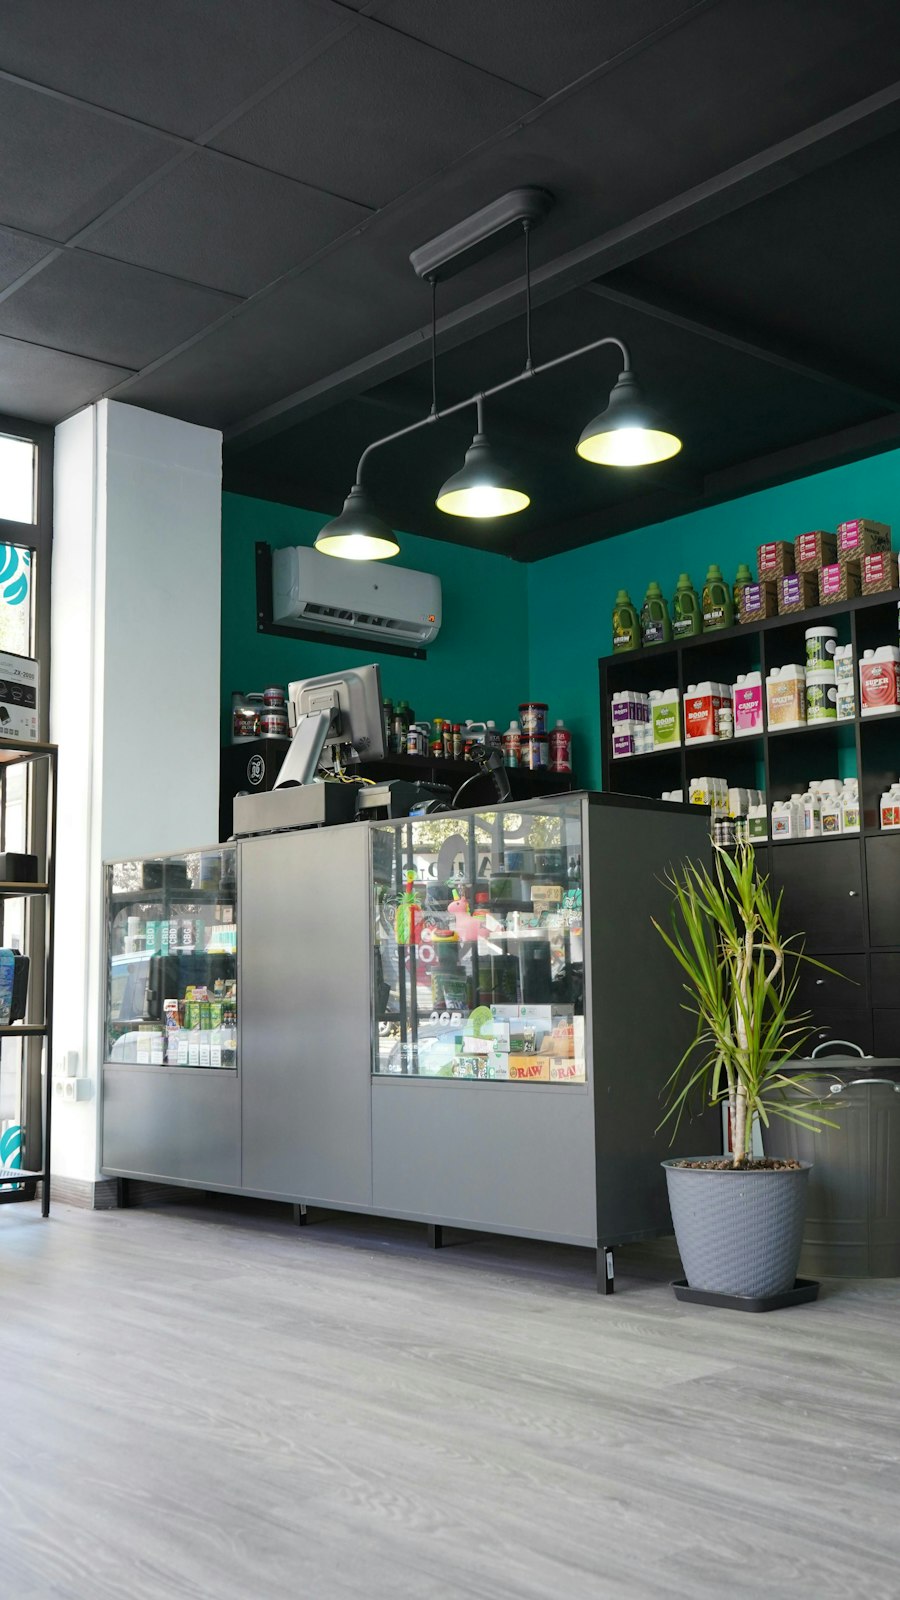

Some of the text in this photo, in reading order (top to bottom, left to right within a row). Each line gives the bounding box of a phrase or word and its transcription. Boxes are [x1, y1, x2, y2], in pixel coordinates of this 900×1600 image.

[865, 677, 889, 686] SUPER
[739, 701, 759, 710] CANDY
[146, 928, 155, 946] CBD
[169, 928, 177, 945] CBD
[183, 928, 192, 945] CBG
[431, 1011, 462, 1026] OCB
[517, 1065, 543, 1079] RAW
